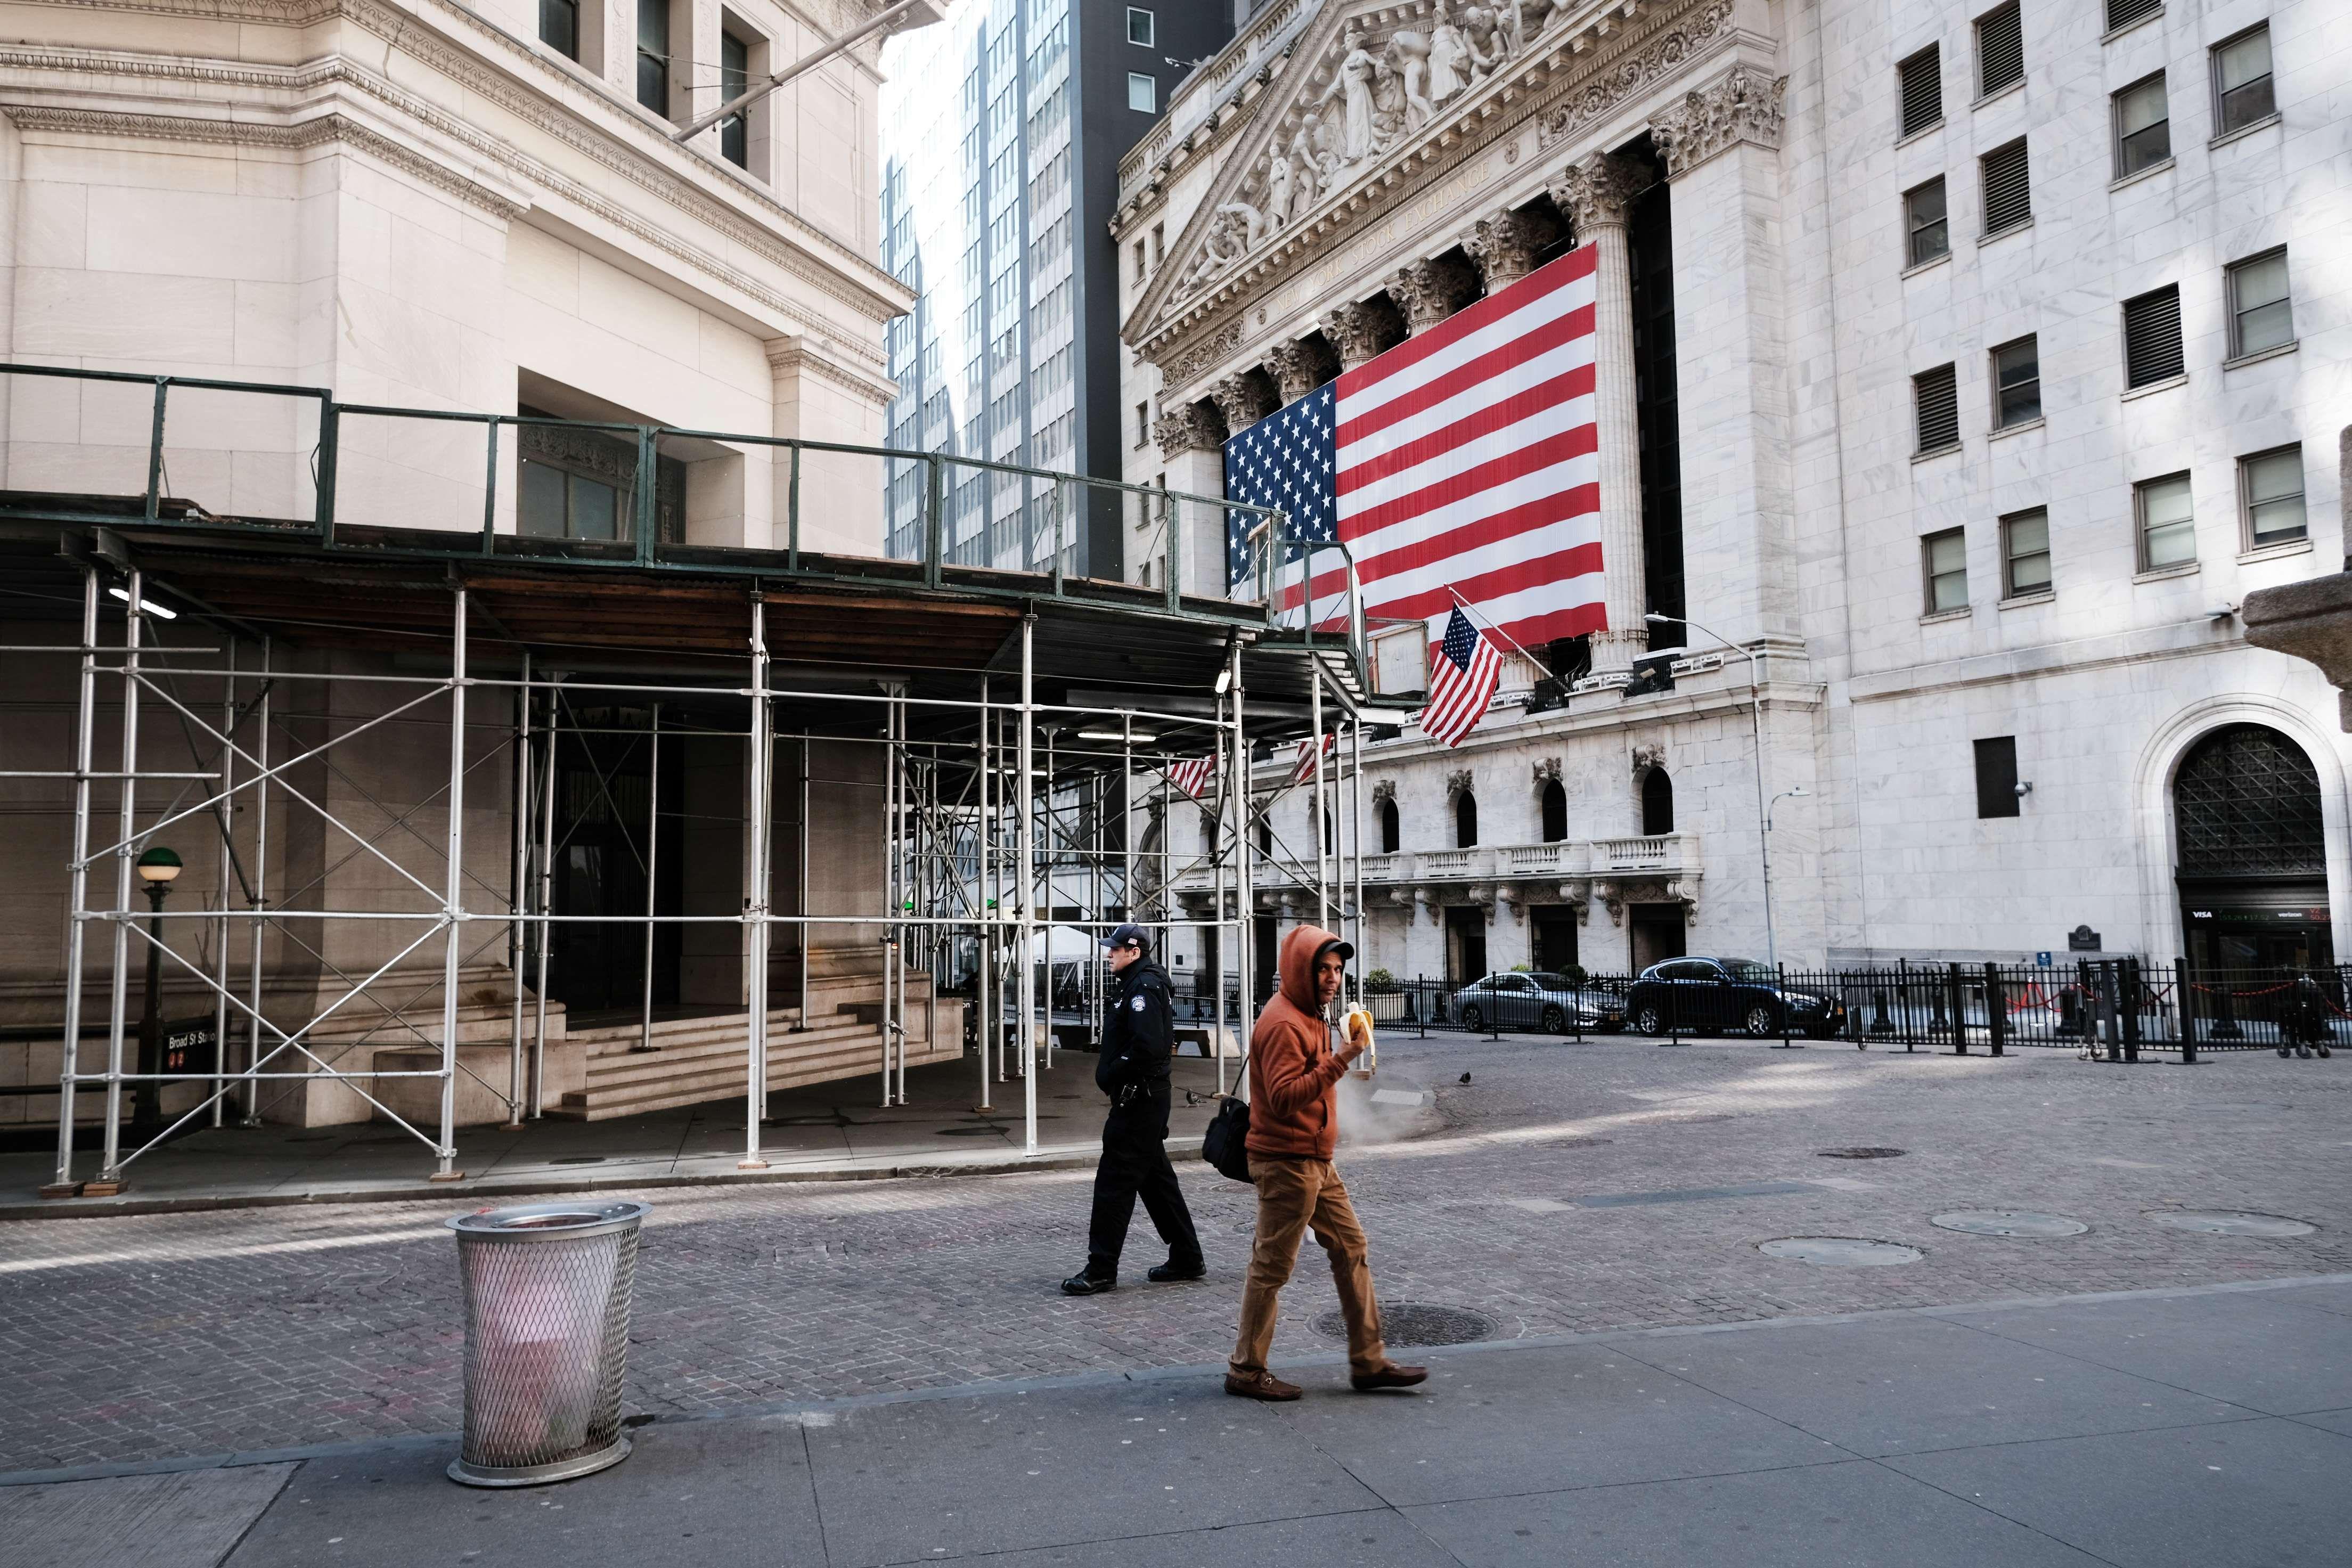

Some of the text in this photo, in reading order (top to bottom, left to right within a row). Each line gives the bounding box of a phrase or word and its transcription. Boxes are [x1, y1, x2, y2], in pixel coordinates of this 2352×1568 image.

[1277, 160, 1491, 315] NEW YORK STOCK EXCHANGE
[169, 1034, 188, 1049] Broad
[190, 1033, 197, 1046] St
